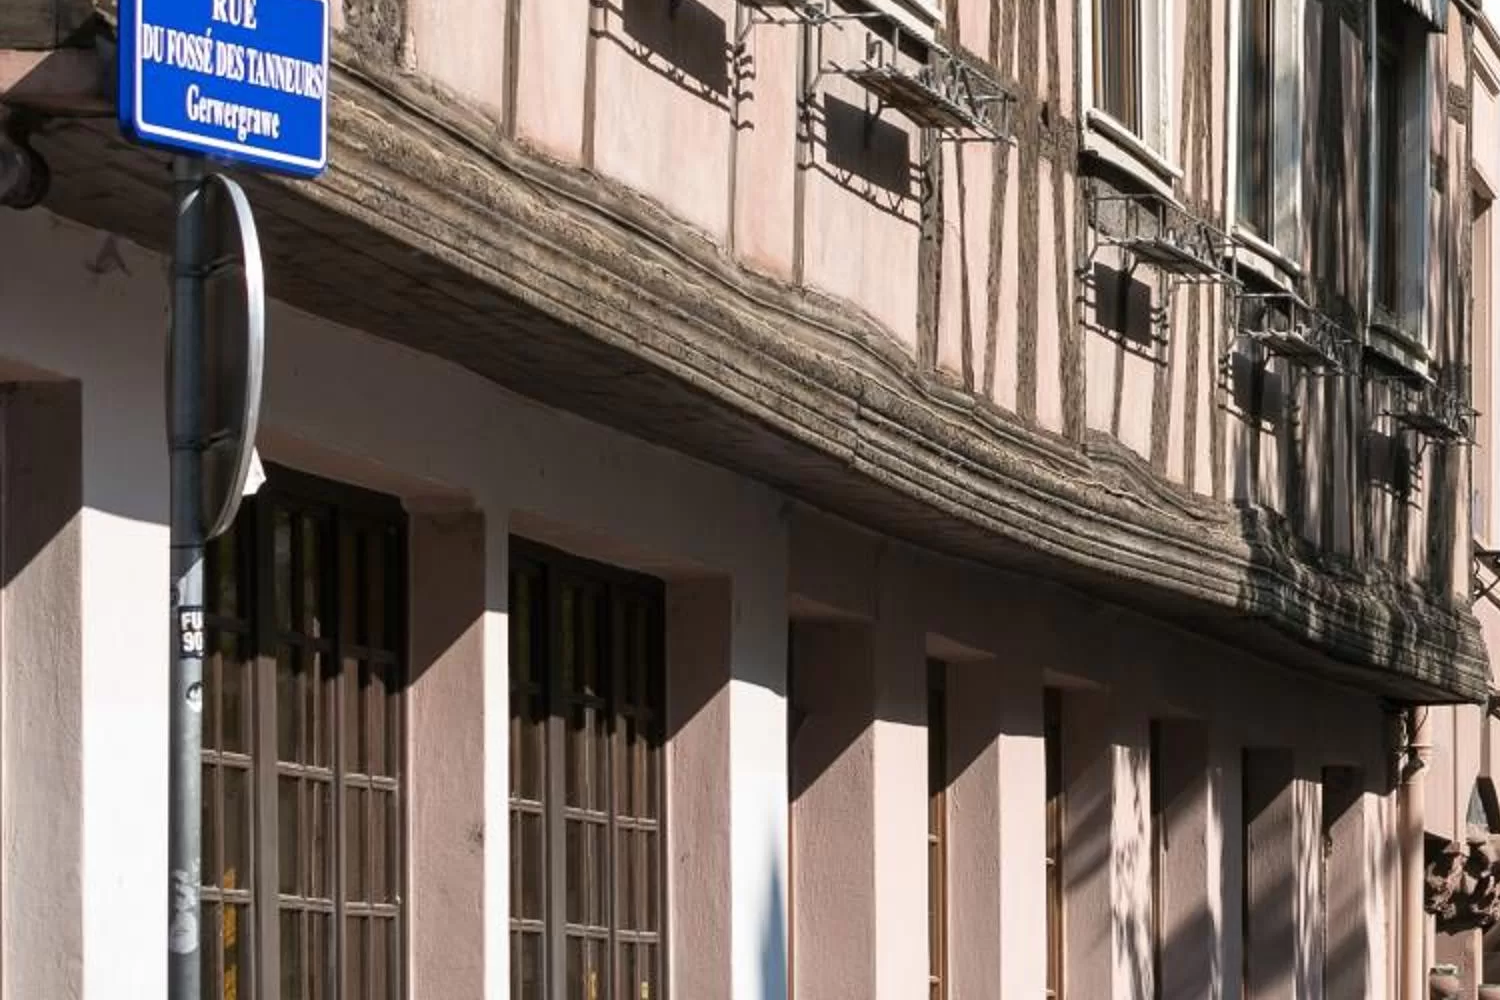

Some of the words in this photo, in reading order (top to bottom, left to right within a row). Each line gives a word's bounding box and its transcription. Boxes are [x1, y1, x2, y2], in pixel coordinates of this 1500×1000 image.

[142, 23, 165, 62] DU
[167, 27, 213, 76] FOSSÉ
[215, 40, 244, 82] DES
[247, 48, 323, 99] TANNEURS
[186, 84, 280, 141] Gerwergrawe
